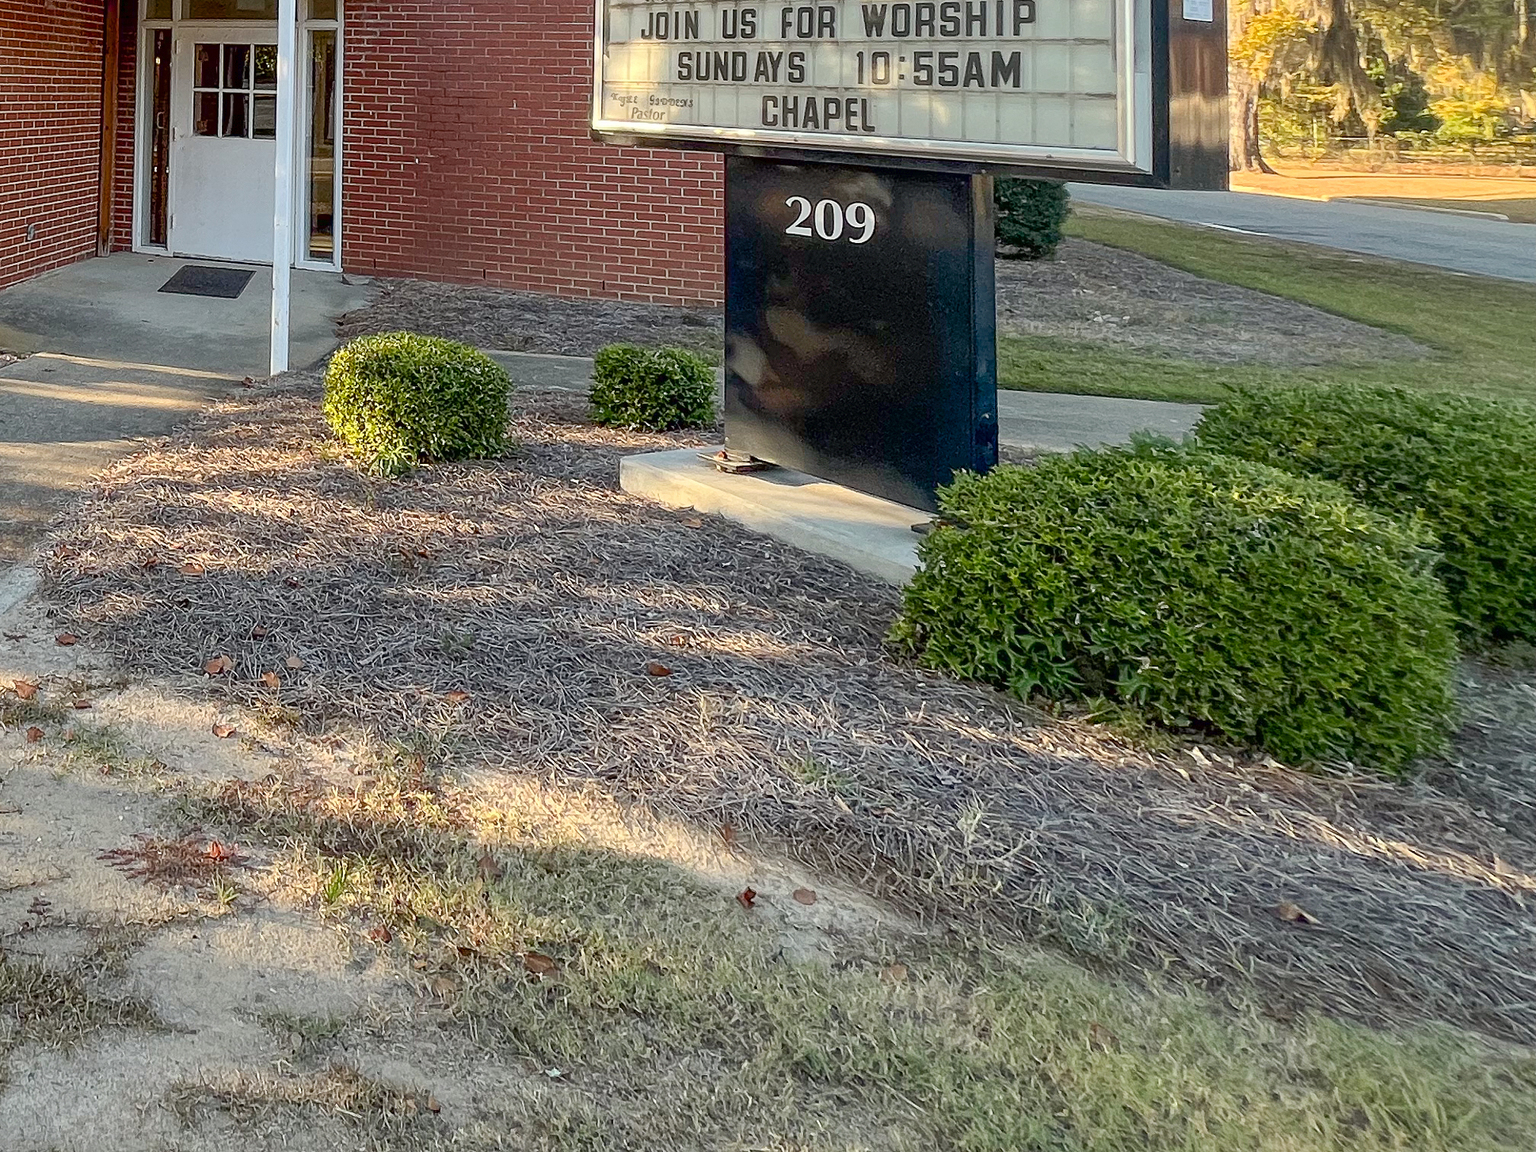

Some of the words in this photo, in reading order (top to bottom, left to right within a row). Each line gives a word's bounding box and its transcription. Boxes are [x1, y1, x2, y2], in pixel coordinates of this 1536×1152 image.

[640, 10, 700, 40] JOIN
[722, 8, 757, 39] US
[780, 6, 836, 39] FOR
[861, 0, 1036, 38] WORSHIP
[677, 51, 806, 84] SUNDAYS
[856, 51, 1022, 89] 10:55AM
[631, 107, 666, 121] Pastor
[761, 95, 876, 133] CHAPEL
[784, 195, 877, 244] 209
